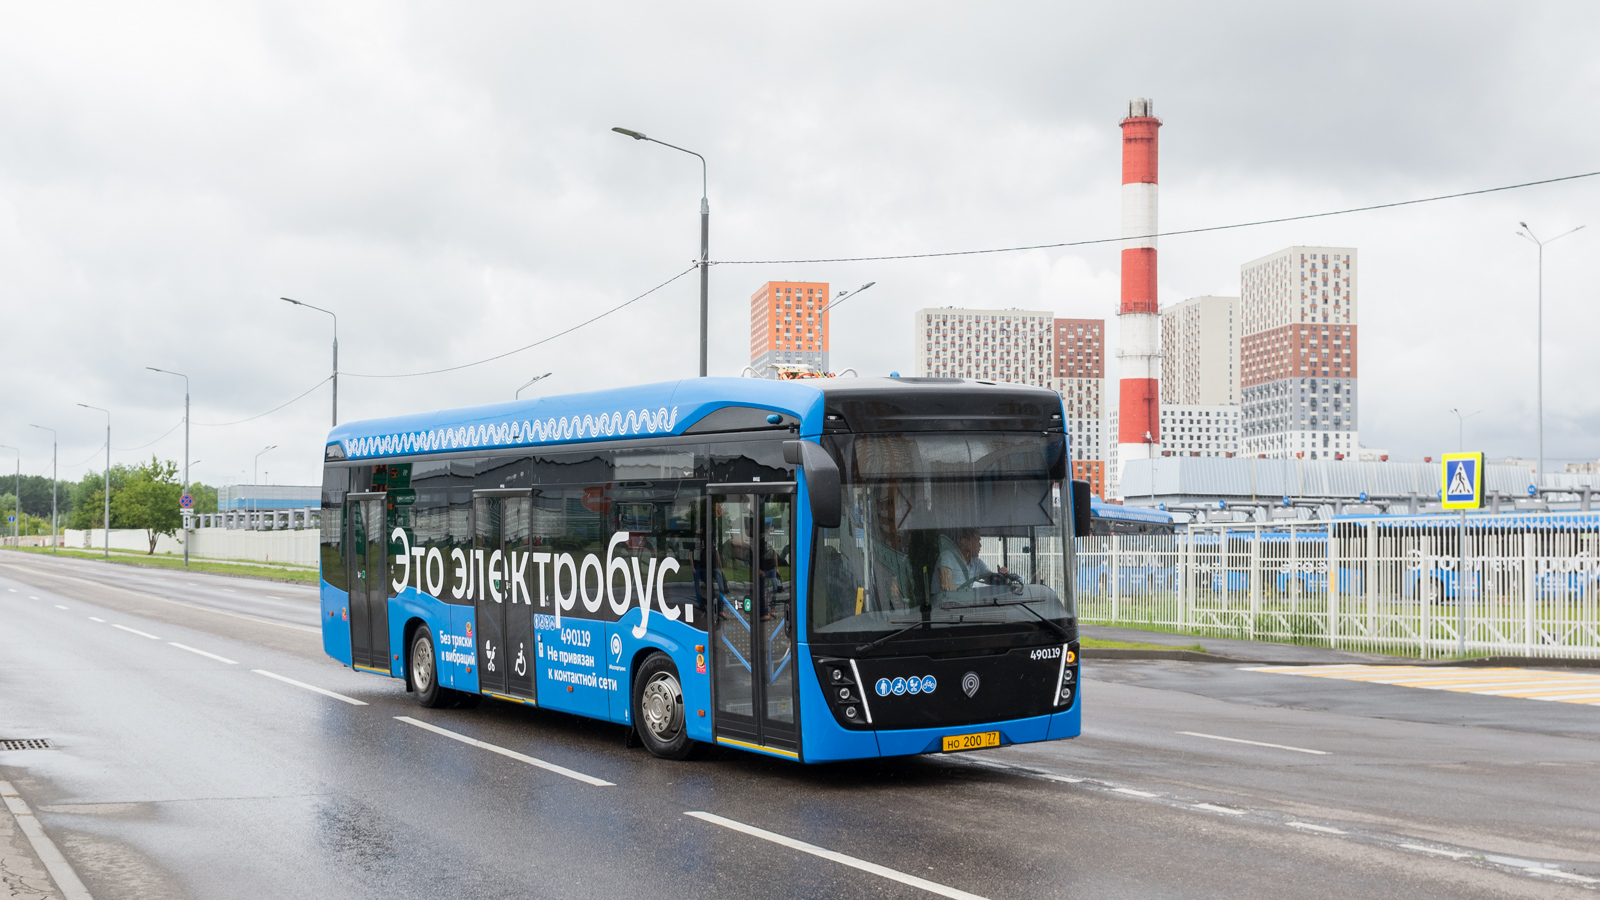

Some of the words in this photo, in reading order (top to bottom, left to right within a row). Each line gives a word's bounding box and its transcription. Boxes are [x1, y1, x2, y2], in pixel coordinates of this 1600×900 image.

[391, 527, 444, 597] Это
[451, 531, 694, 639] электробус.
[439, 630, 451, 645] Без
[451, 635, 473, 649] тряски
[560, 628, 591, 647] 490119
[445, 648, 476, 667] вибраций
[547, 645, 558, 661] Не
[559, 650, 595, 668] привязан
[1030, 647, 1061, 660] 490119
[554, 668, 598, 688] контактной
[598, 676, 618, 692] сети
[964, 735, 982, 748] 200
[987, 732, 997, 742] 77
